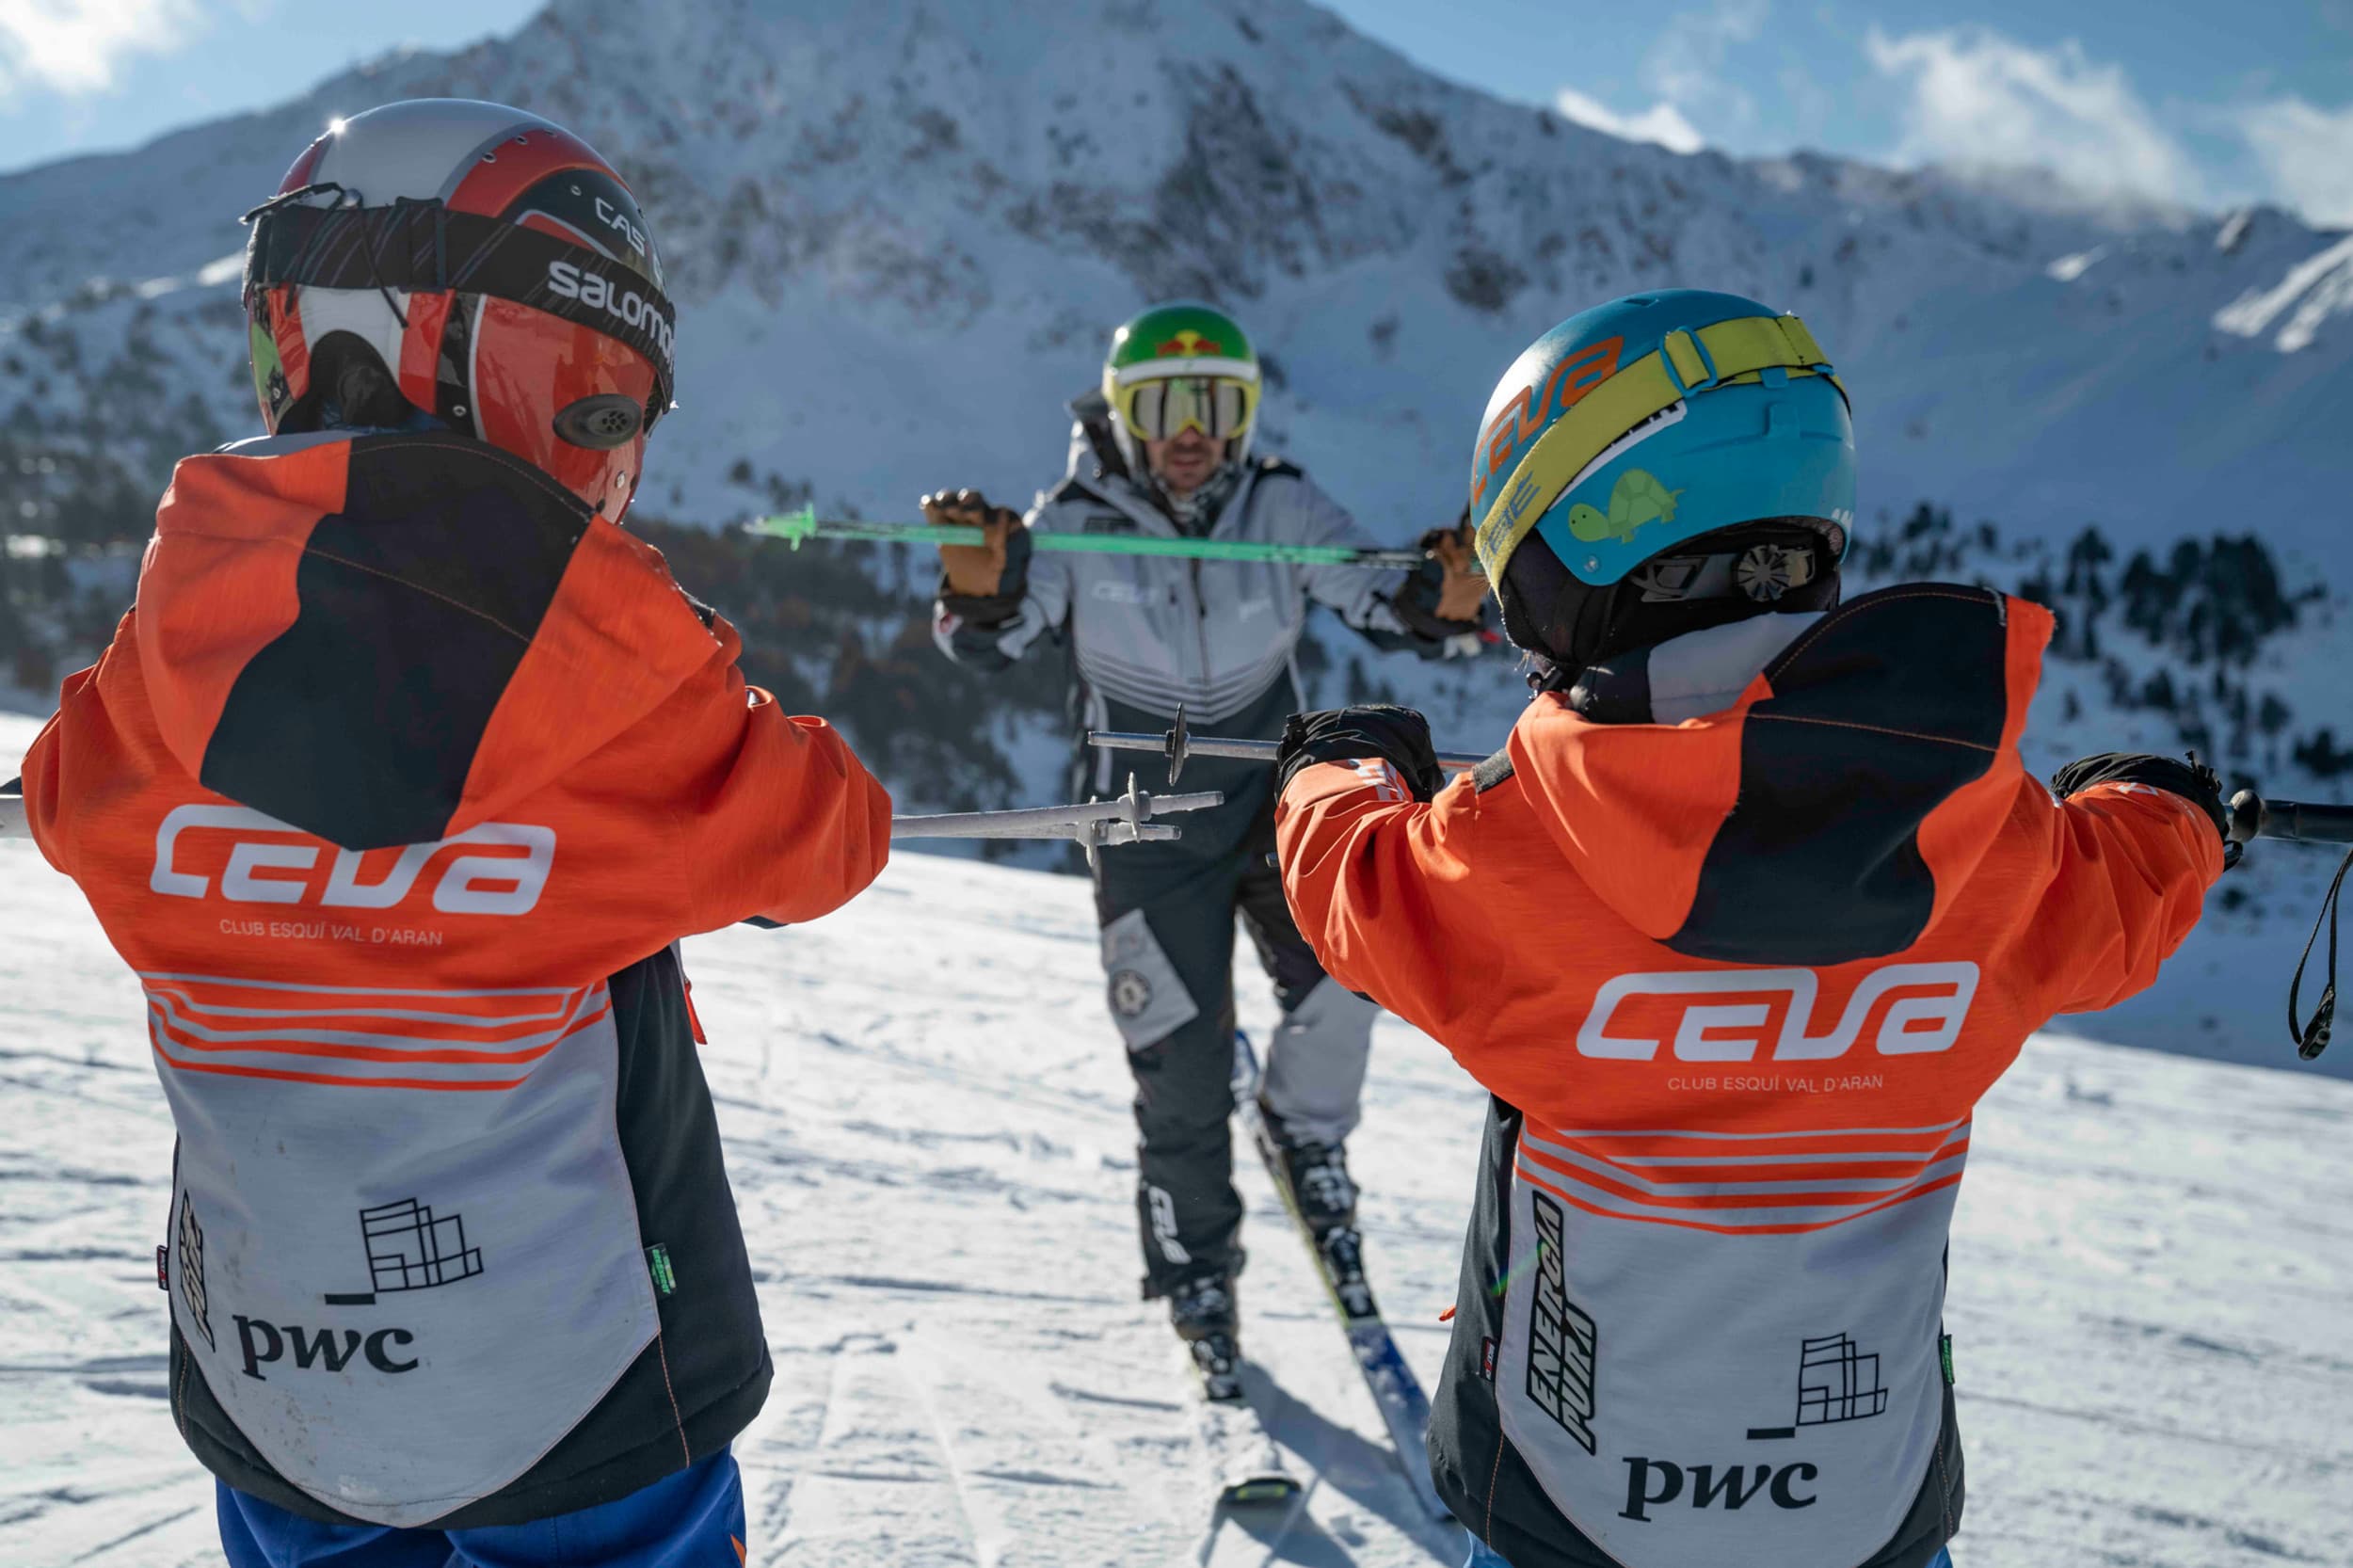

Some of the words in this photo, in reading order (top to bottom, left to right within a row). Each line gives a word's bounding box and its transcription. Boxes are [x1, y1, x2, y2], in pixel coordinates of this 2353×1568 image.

[150, 804, 556, 916] CEVA
[219, 919, 264, 936] CLUB
[330, 924, 365, 942] VAL
[372, 927, 442, 945] D'ARAN
[1576, 961, 1980, 1062] CEVA
[1668, 1077, 1717, 1091] CLUB
[1785, 1077, 1819, 1094] VAL
[1824, 1073, 1883, 1093] D'ARAN
[232, 1314, 419, 1381] pwc
[1618, 1456, 1818, 1522] pwc
